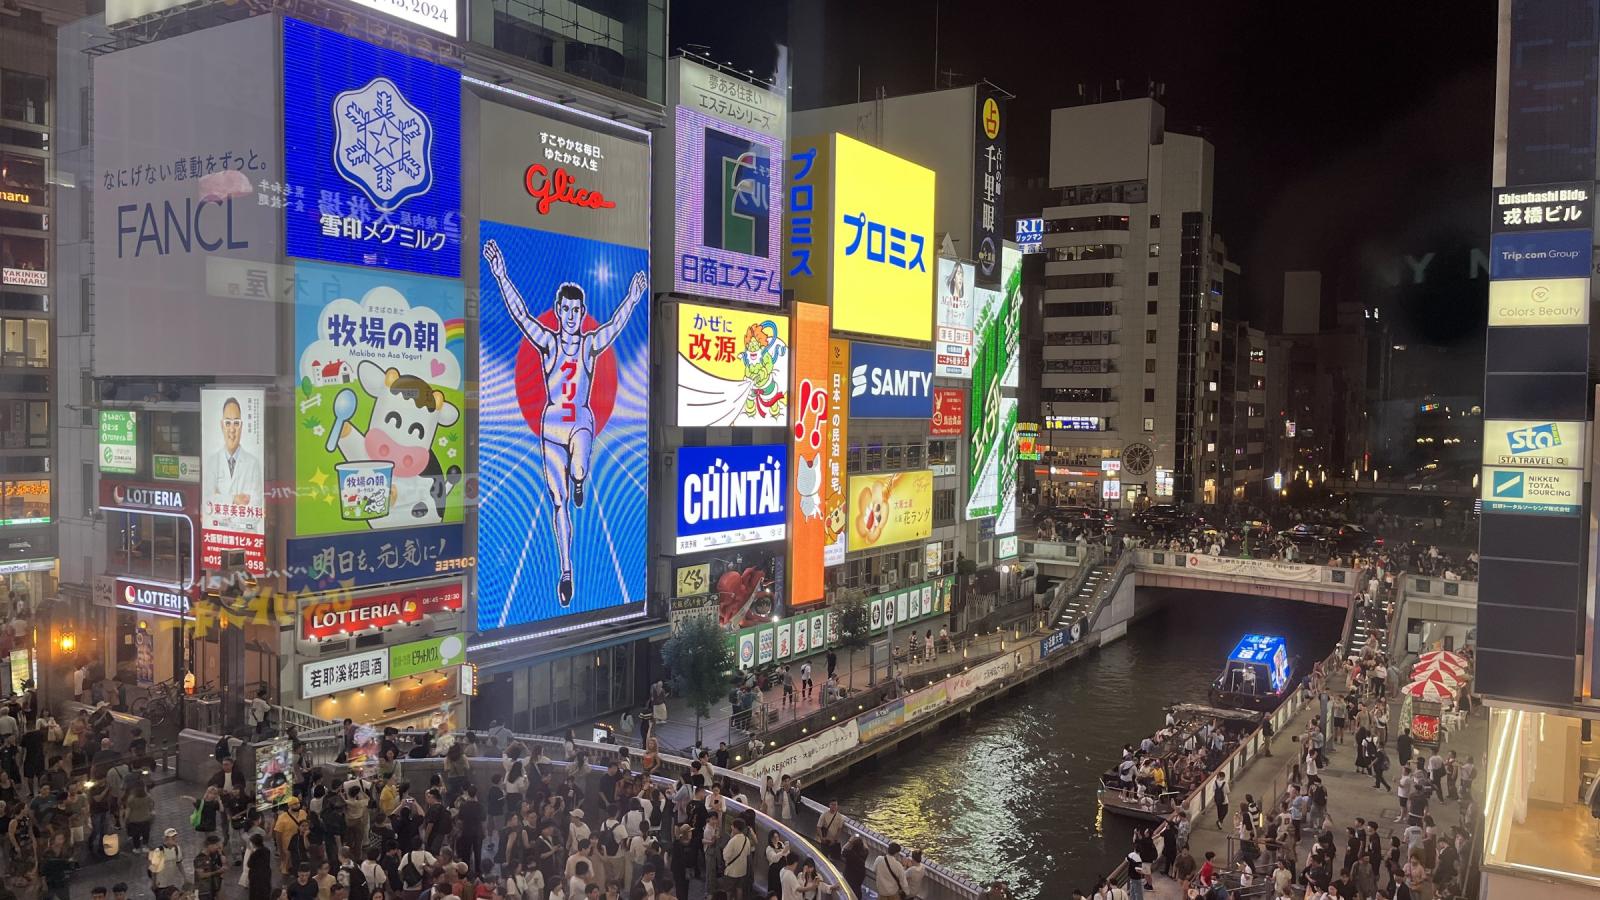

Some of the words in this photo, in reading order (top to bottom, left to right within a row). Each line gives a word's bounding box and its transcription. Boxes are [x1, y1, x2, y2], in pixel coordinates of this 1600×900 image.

[708, 74, 762, 105] 夢ある住まい
[985, 100, 997, 134] 占
[539, 131, 605, 159] すこやかな毎日、
[103, 149, 267, 190] なにげない感動をずっと。
[544, 147, 599, 171] ゆたかな人生
[525, 163, 617, 215] Glico
[982, 143, 996, 232] 千里眼
[1498, 191, 1559, 205] Ebisubashi
[1560, 189, 1588, 201] Bldg.
[789, 147, 817, 276] プロミス
[1503, 205, 1582, 225] 戎橋ビル
[117, 197, 249, 258] FANCL
[320, 213, 446, 251] 雪印メグミルク
[844, 212, 926, 273] プロミス
[1502, 251, 1547, 262] Trip.com
[1548, 249, 1578, 260] Group
[3, 270, 46, 280] YAKINIKU
[3, 276, 46, 286] RIKIMARU
[681, 253, 783, 294] 日商エステム
[693, 313, 733, 333] かぜに
[1499, 307, 1535, 317] Colors
[1538, 306, 1580, 318] Beauty
[328, 314, 439, 353] 牧場の朝
[401, 352, 423, 361] Yogurt
[688, 333, 736, 362] 改源
[560, 358, 578, 422] グリコ
[870, 366, 933, 398] SAMTY
[1511, 428, 1554, 449] sta
[1501, 456, 1517, 464] STA
[1519, 456, 1550, 465] TRAVEL
[346, 475, 385, 487] 牧場の朝
[1528, 475, 1560, 483] NIKKEN
[126, 488, 183, 507] LOTTERIA
[1528, 489, 1571, 497] SOURCING
[214, 503, 263, 519] 東京美容外科
[254, 538, 265, 548] 2F
[137, 587, 190, 611] LOTTERIA
[312, 602, 400, 629] LOTTERIA
